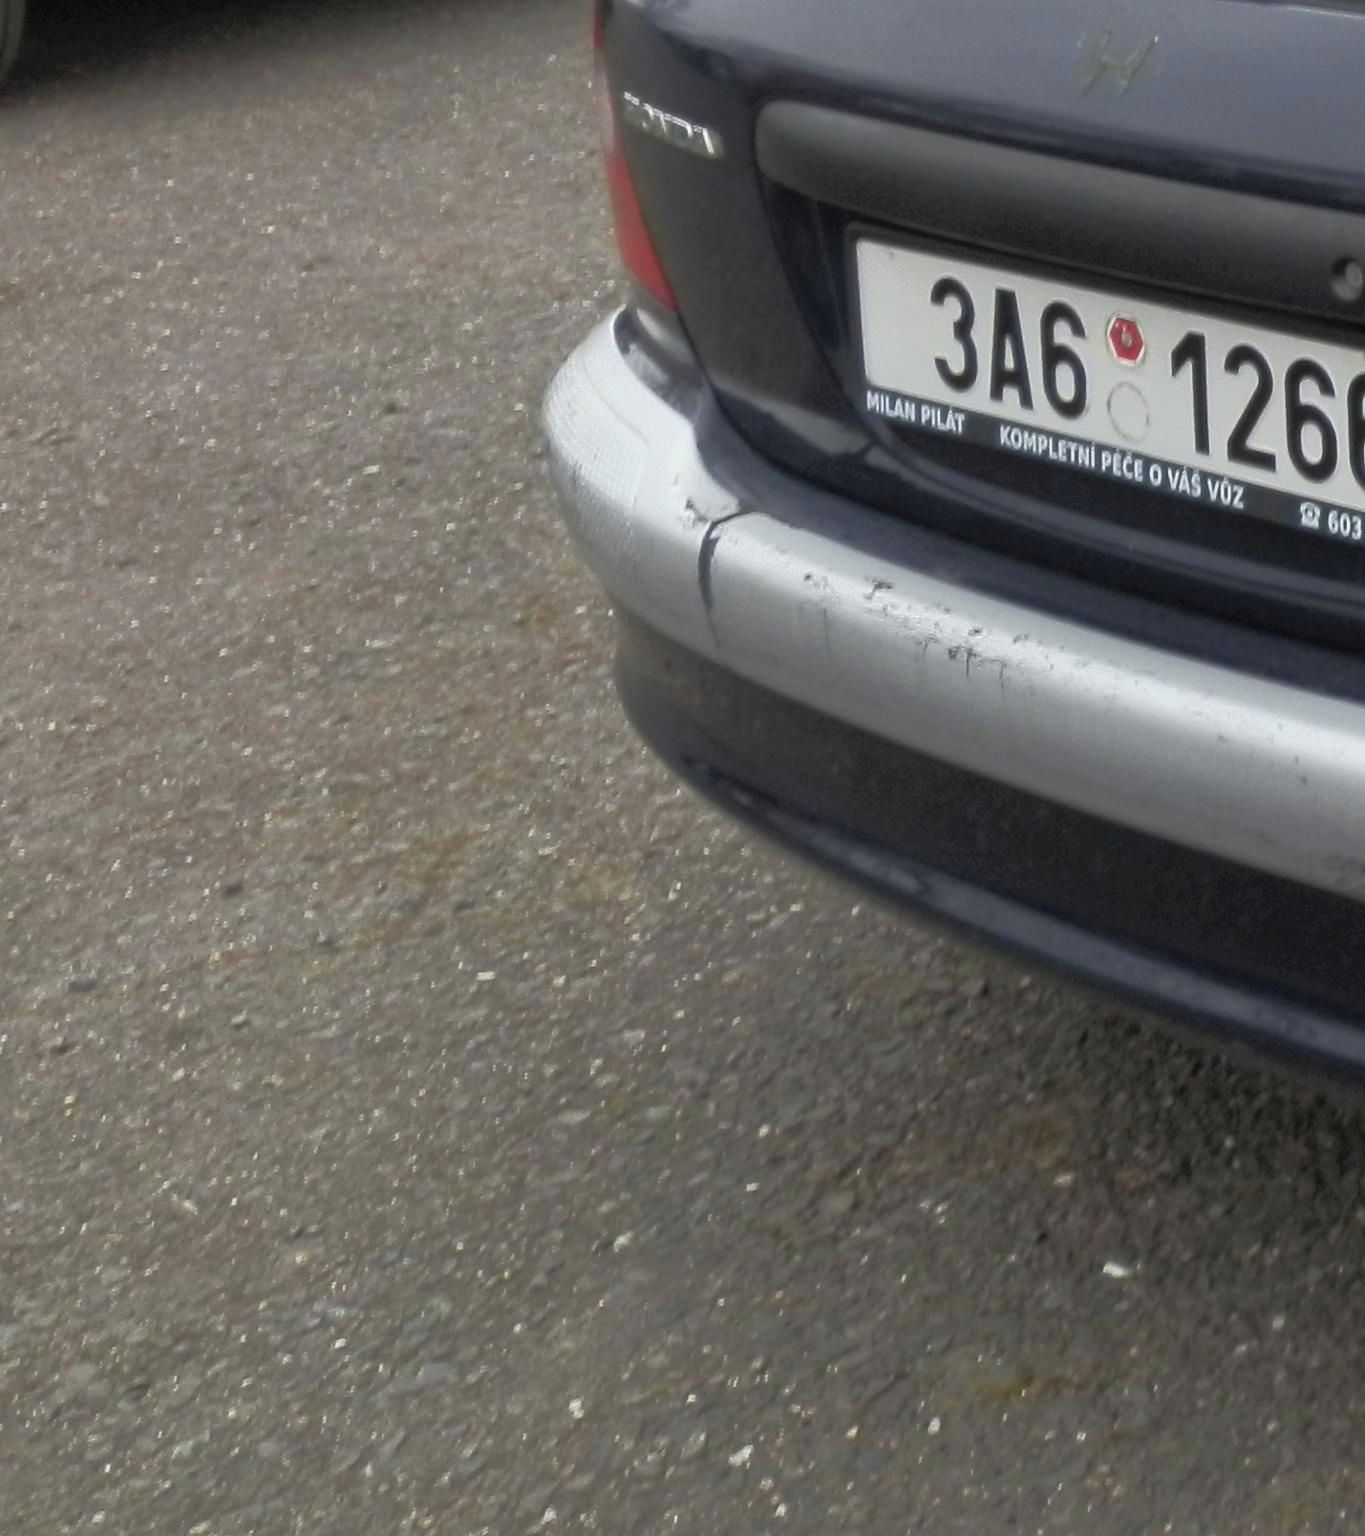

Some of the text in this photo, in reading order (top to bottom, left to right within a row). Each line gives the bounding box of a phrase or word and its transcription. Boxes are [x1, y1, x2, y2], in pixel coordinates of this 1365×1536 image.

[929, 276, 1089, 420] 3A6
[865, 391, 966, 435] MILAN PILÁT
[999, 424, 1097, 469] KOMPLETNÍ
[1101, 446, 1144, 482] PÉČE
[1148, 462, 1163, 485] O
[1166, 464, 1202, 498] VÁŠ
[1326, 509, 1363, 541] 603
